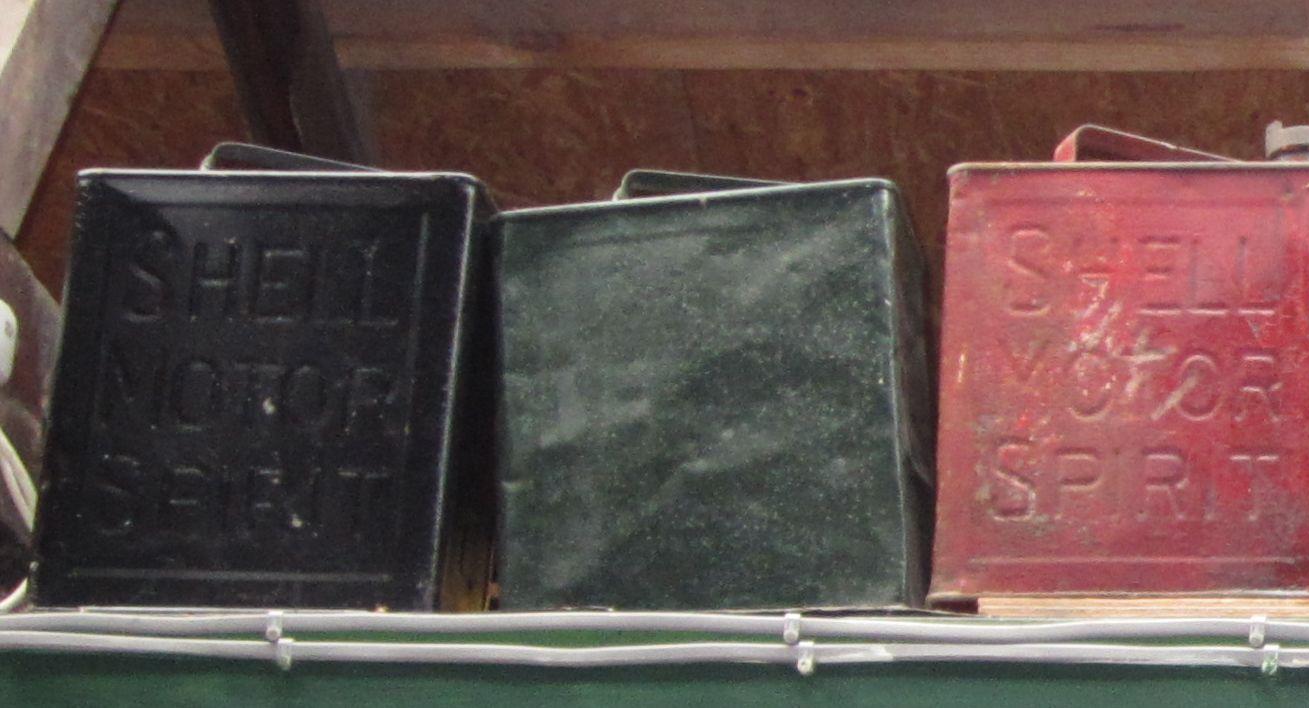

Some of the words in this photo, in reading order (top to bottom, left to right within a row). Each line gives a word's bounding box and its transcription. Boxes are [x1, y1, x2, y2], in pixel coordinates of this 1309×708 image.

[118, 228, 401, 326] SHELL
[1007, 226, 1277, 317] SHELL
[97, 340, 395, 432] MOTOR
[1004, 330, 1283, 423] MOTOR
[96, 452, 391, 538] SPIRIT
[991, 436, 1281, 522] SPIRIT
